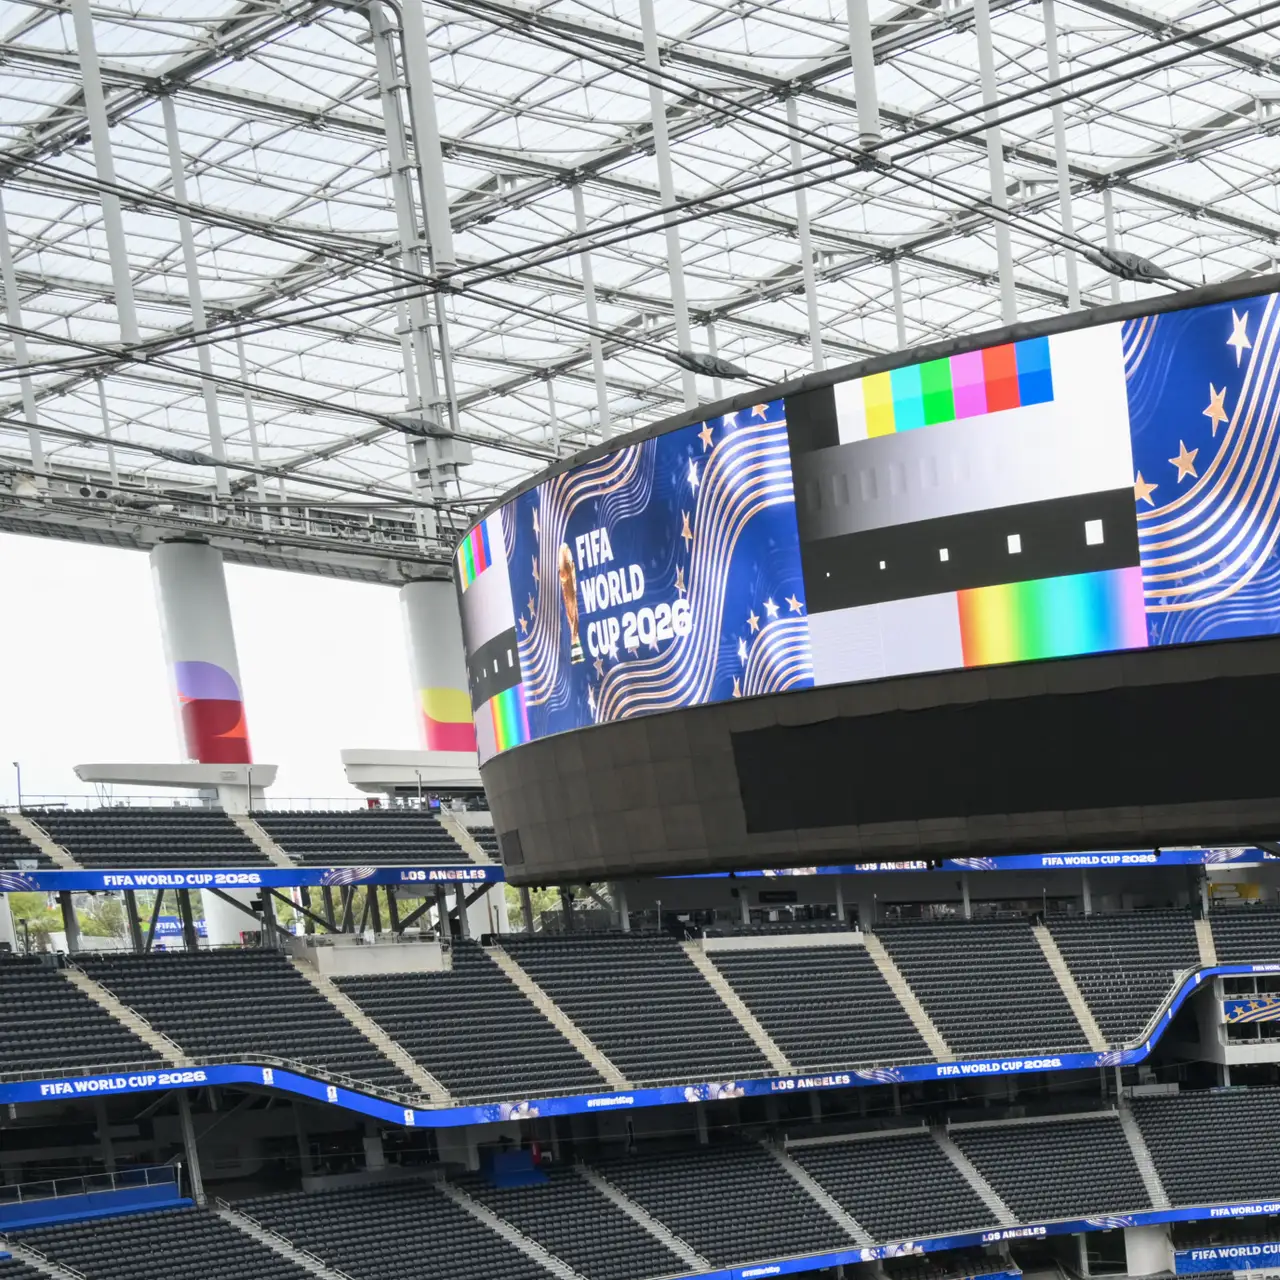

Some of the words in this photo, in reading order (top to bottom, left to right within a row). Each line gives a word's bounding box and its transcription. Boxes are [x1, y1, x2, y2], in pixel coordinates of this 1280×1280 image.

[575, 527, 613, 570] FIFA
[579, 563, 645, 614] WORLD
[587, 610, 622, 658] CUP
[622, 598, 692, 650] 2026
[1043, 858, 1065, 868] FIFA
[1066, 857, 1100, 868] WORLD
[1102, 856, 1121, 866] CUP
[1122, 855, 1158, 866] 2026
[103, 875, 133, 886] FIFA
[134, 874, 185, 886] WORLD
[186, 874, 213, 885] CUP
[214, 873, 262, 884] 2026
[401, 870, 427, 880] LOS
[429, 869, 487, 880] ANGELES
[937, 1065, 960, 1076] FIFA
[961, 1063, 999, 1074] WORLD
[1002, 1060, 1023, 1071] CUP
[1024, 1058, 1063, 1069] 2026
[41, 1083, 74, 1096] FIFA
[75, 1078, 128, 1093] WORLD
[129, 1075, 158, 1088] CUP
[159, 1070, 207, 1085] 2026
[772, 1080, 795, 1091] LOS
[797, 1075, 851, 1089] ANGELES
[1210, 1207, 1230, 1217] FIFA
[1231, 1205, 1262, 1215] WORLD
[1263, 1203, 1280, 1213] CUP
[983, 1232, 1001, 1242] LOS
[1002, 1226, 1047, 1239] ANGELES
[1192, 1250, 1218, 1261] FIFA
[1220, 1246, 1261, 1259] WORLD
